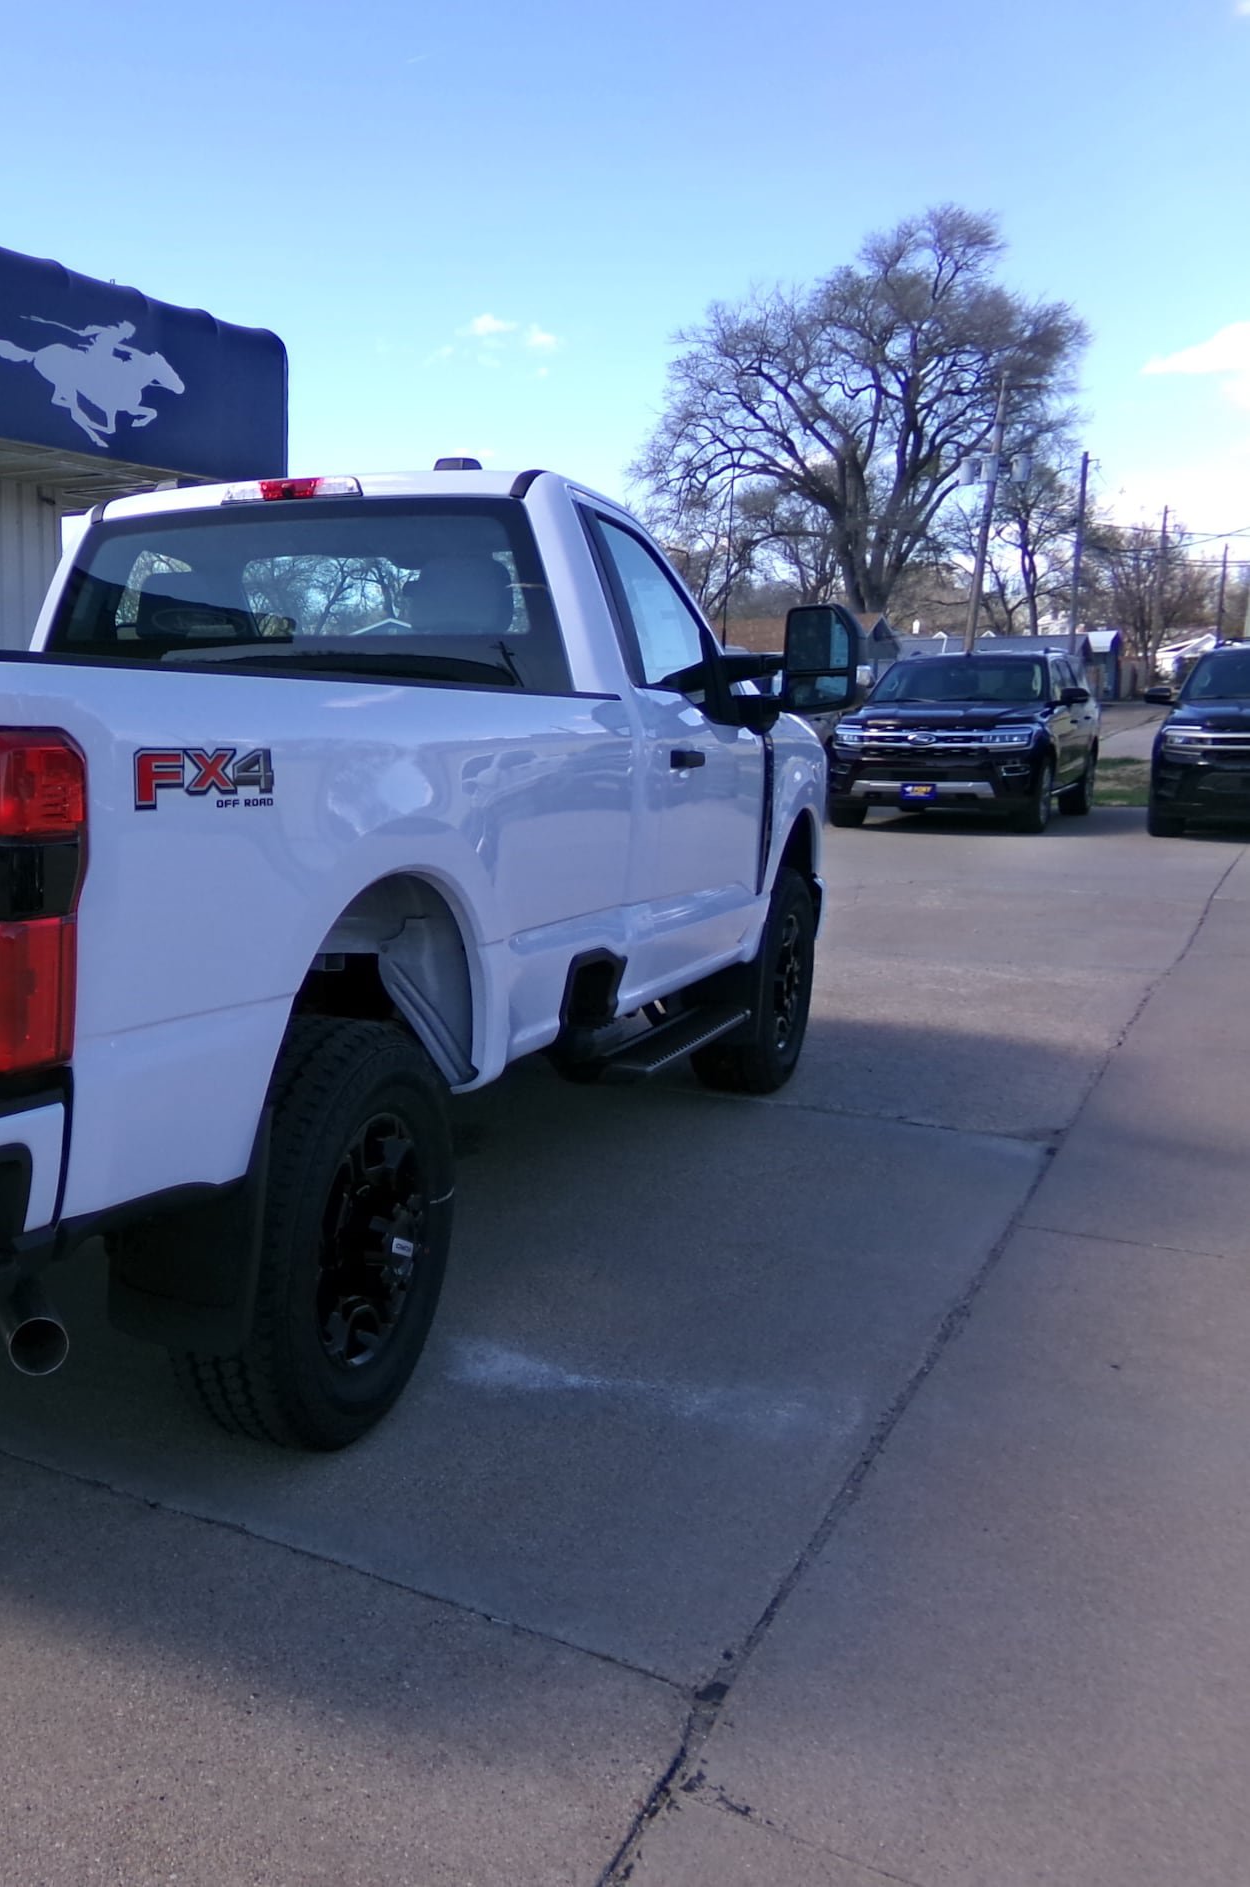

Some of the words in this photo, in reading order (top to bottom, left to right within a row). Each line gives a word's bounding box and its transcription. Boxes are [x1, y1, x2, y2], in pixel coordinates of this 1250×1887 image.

[133, 747, 275, 811] FX4
[216, 798, 240, 808] OFF
[244, 797, 274, 807] ROAD
